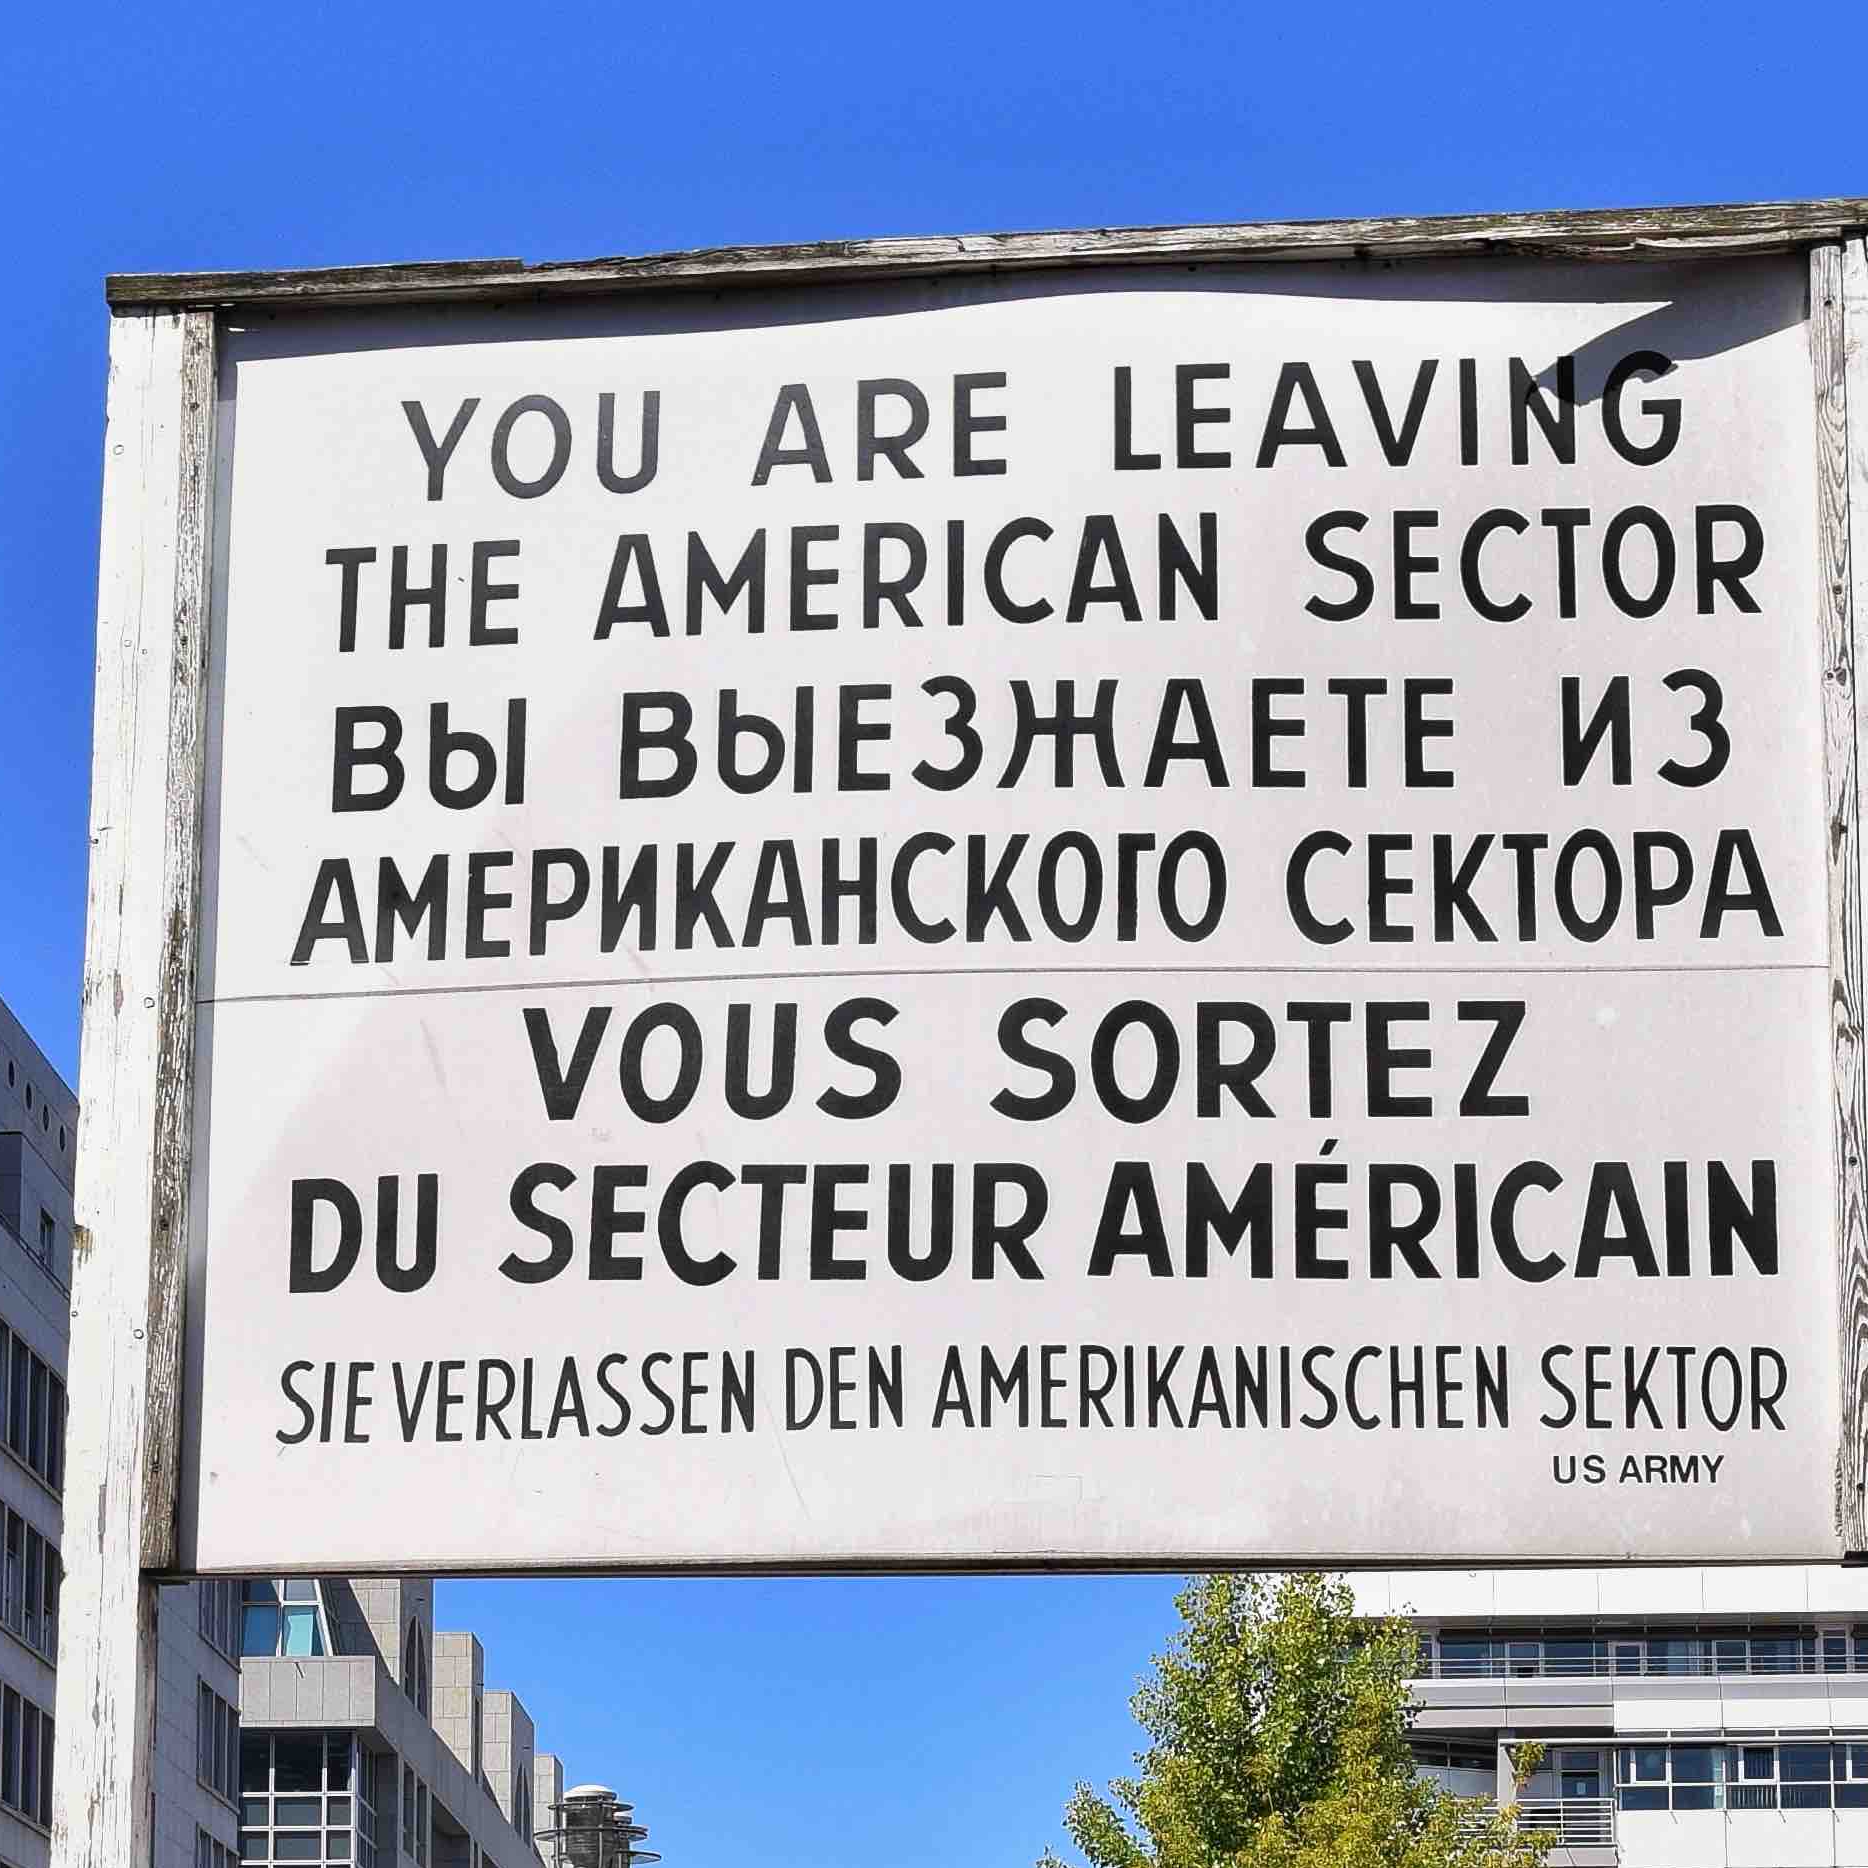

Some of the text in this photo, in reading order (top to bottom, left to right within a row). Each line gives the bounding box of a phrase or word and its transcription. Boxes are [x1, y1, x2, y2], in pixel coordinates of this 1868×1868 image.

[402, 352, 1684, 501] YOU ARE LEAVING
[326, 505, 1763, 652] THE AMERICAN SECTOR
[332, 669, 1730, 812] ВЫ ВЫЕЗЖАЕТЕ ИЗ
[292, 829, 1783, 963] АМЕРИКАНСКОГО СЕКТОРА
[523, 998, 1529, 1123] VOUS SORTEZ
[290, 1139, 1778, 1293] DU SECTEUR AMÉRICAIN
[276, 1345, 1787, 1444] SIE VERLASSEN DEN AMERIKANISCHEN SEKTOR
[1554, 1455, 1724, 1483] US ARMY
